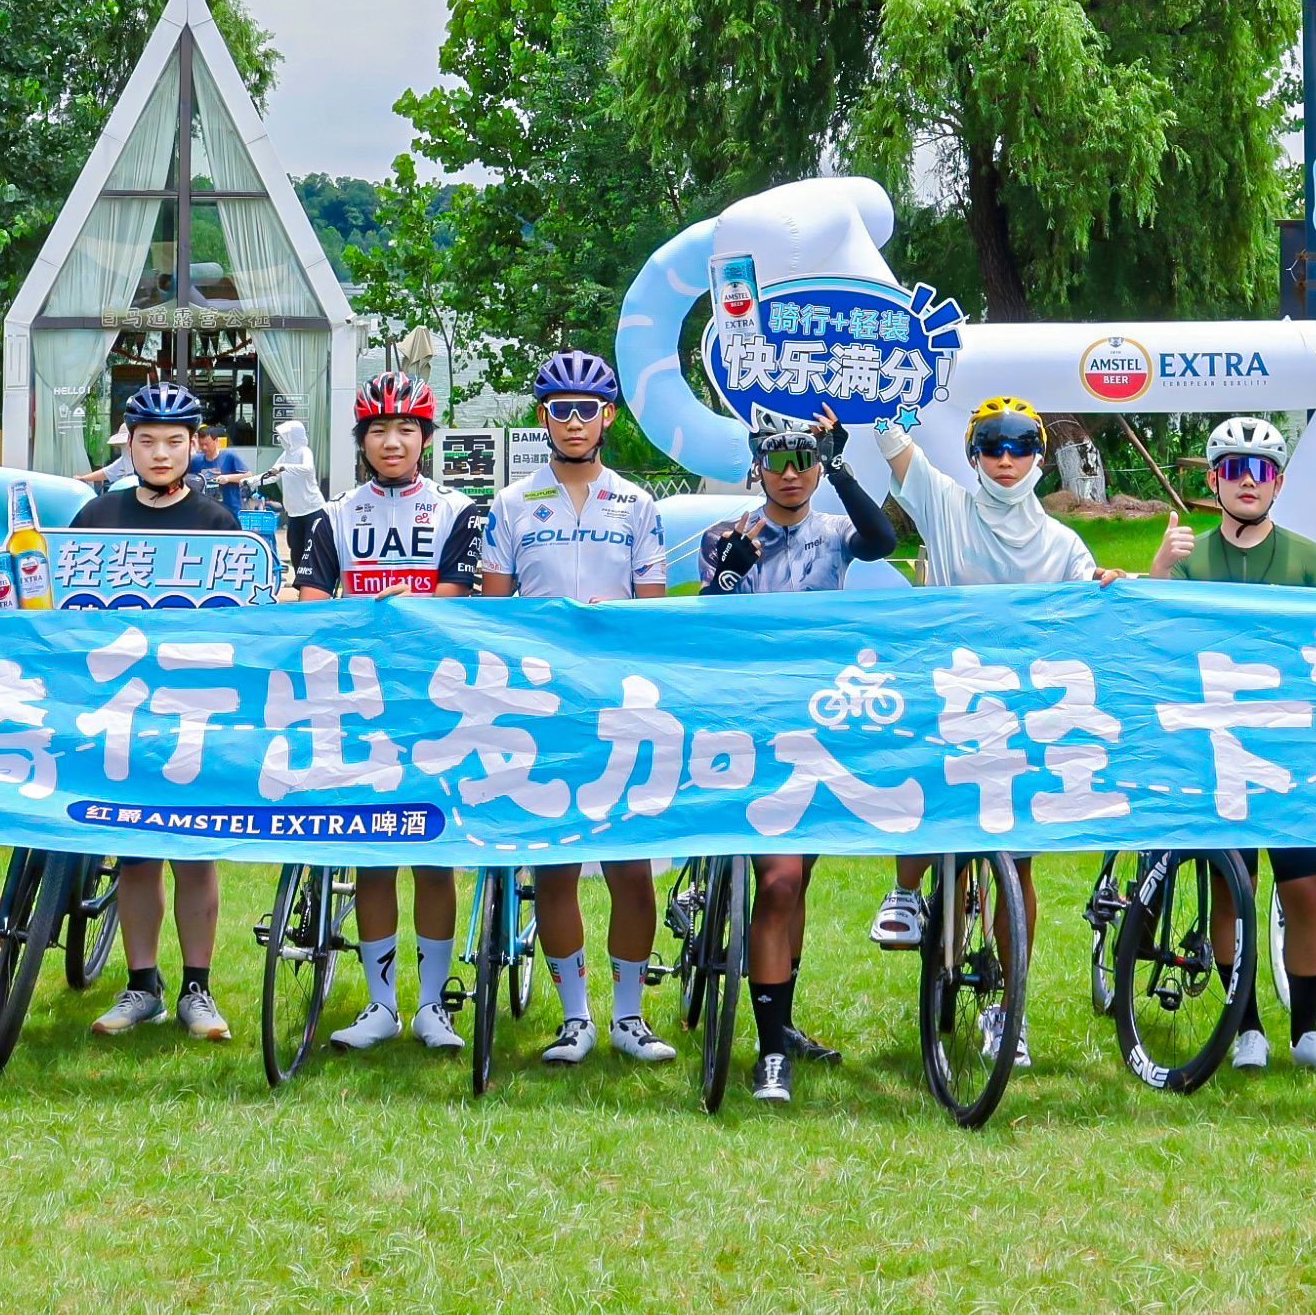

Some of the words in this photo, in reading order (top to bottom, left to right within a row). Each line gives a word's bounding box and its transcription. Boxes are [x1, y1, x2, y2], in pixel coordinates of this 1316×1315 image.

[100, 306, 272, 329] 白马道露营公社
[725, 318, 755, 330] EXTRA
[768, 301, 910, 343] 骑行+轻装
[724, 334, 951, 404] 快乐满分!
[1090, 358, 1142, 371] AMSTEL
[1159, 351, 1270, 378] EXTRA
[1103, 375, 1129, 385] BEER
[415, 502, 433, 512] FAB
[607, 491, 639, 504] PNS
[352, 527, 435, 559] UAE
[54, 540, 260, 591] 轻装上阵
